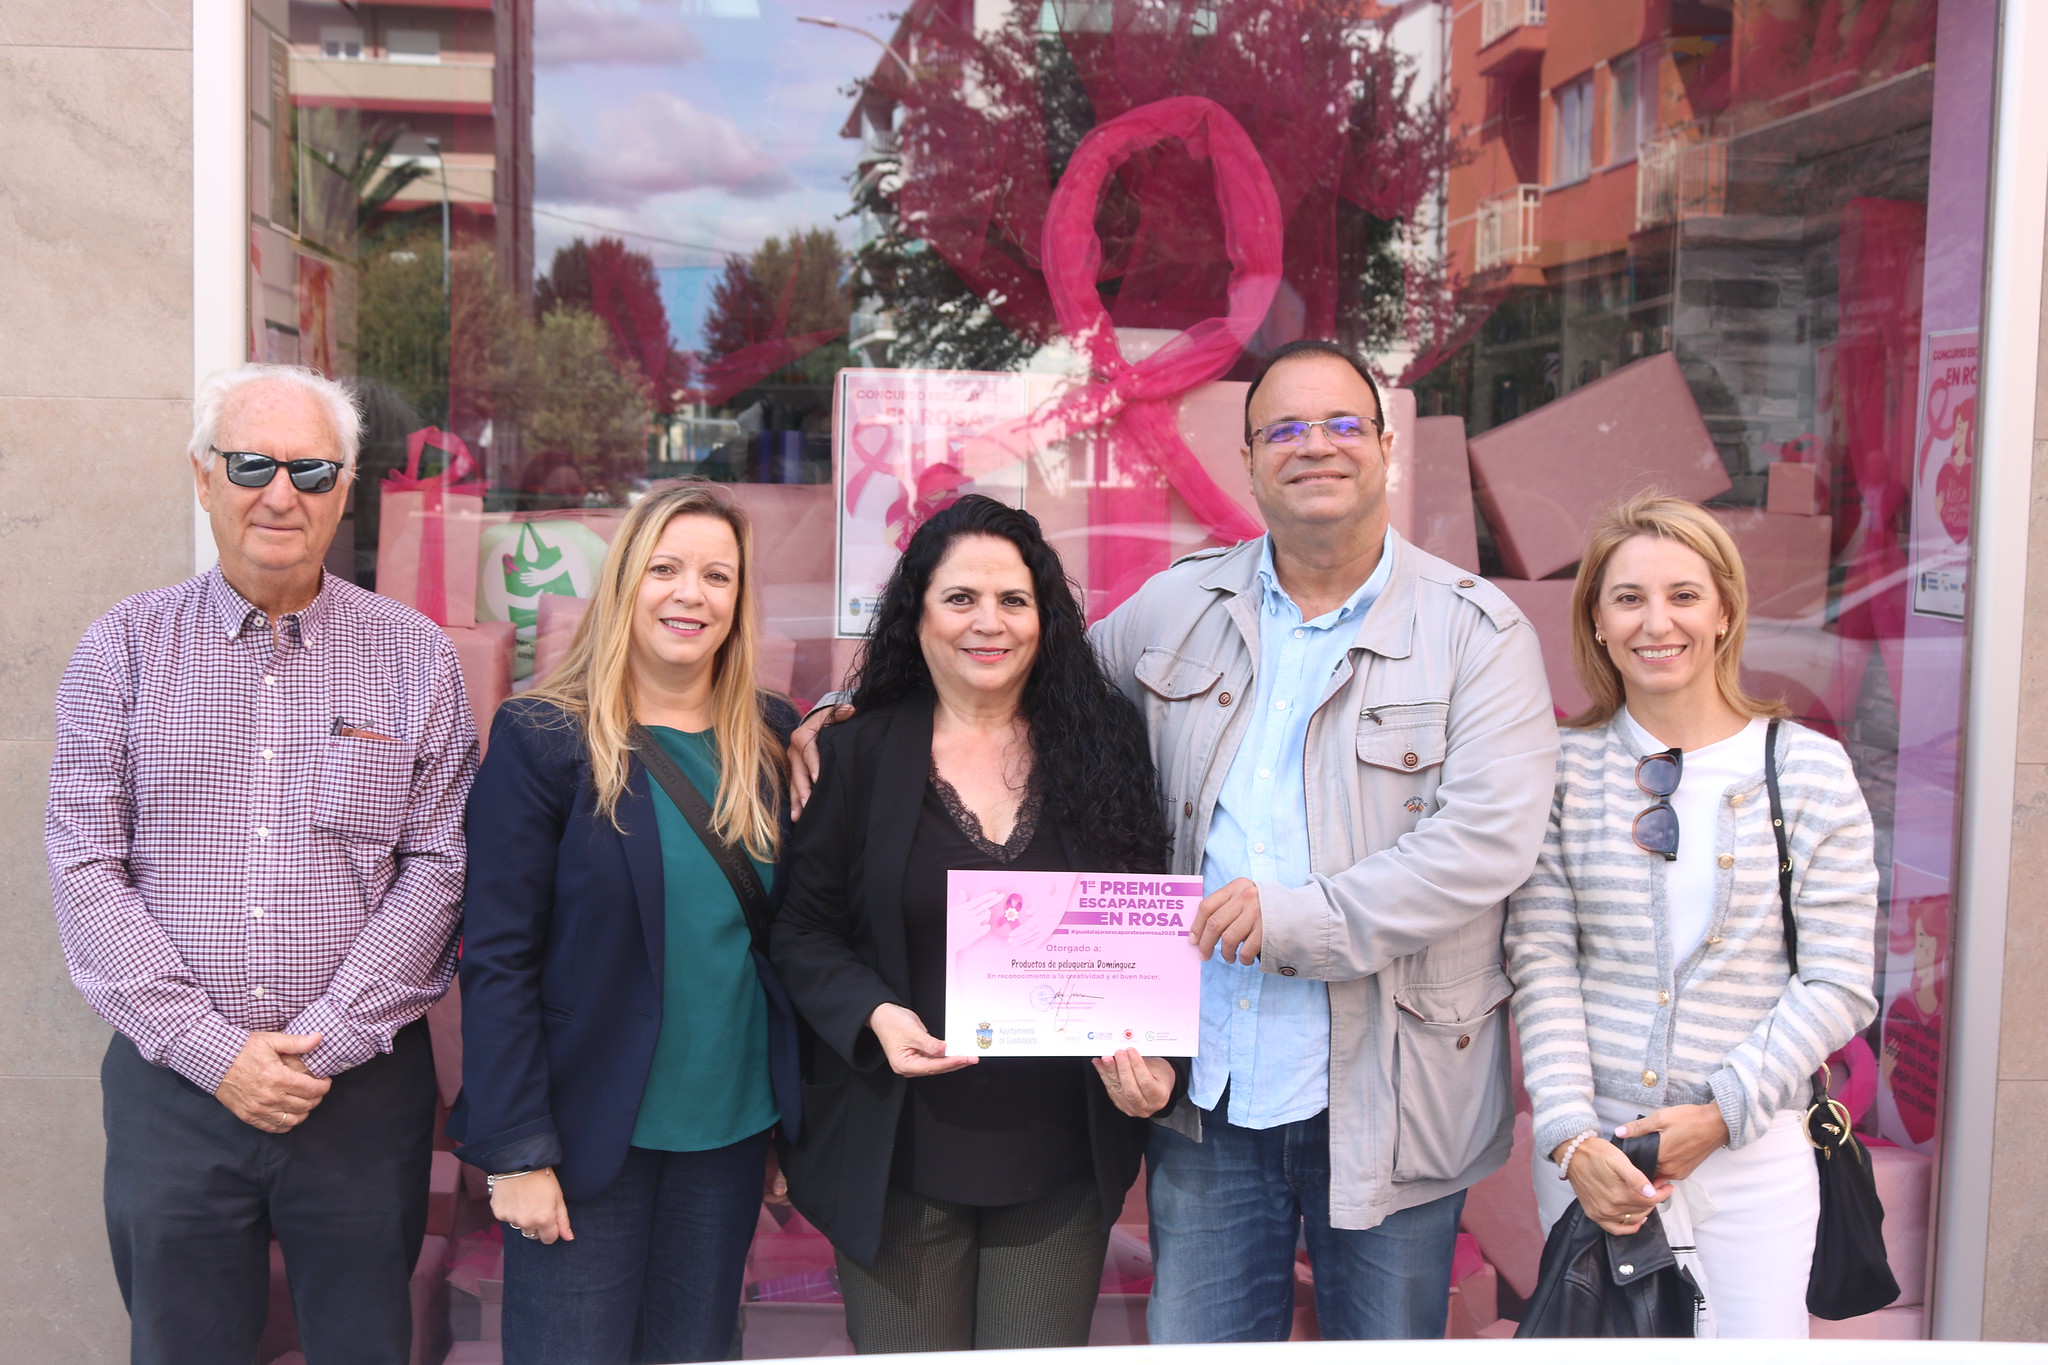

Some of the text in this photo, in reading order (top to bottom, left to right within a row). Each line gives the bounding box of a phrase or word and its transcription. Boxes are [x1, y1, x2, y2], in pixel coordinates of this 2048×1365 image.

[1946, 367, 1960, 386] EN
[920, 408, 983, 428] ROSA
[1100, 881, 1174, 896] PREMIO
[1079, 898, 1184, 910] ESCAPARATES
[1100, 912, 1184, 927] EN ROSA
[1046, 944, 1090, 954] Otorgado
[1012, 959, 1136, 970] Productos de peluquería Domínguez
[1007, 1037, 1037, 1045] Guadalajara
